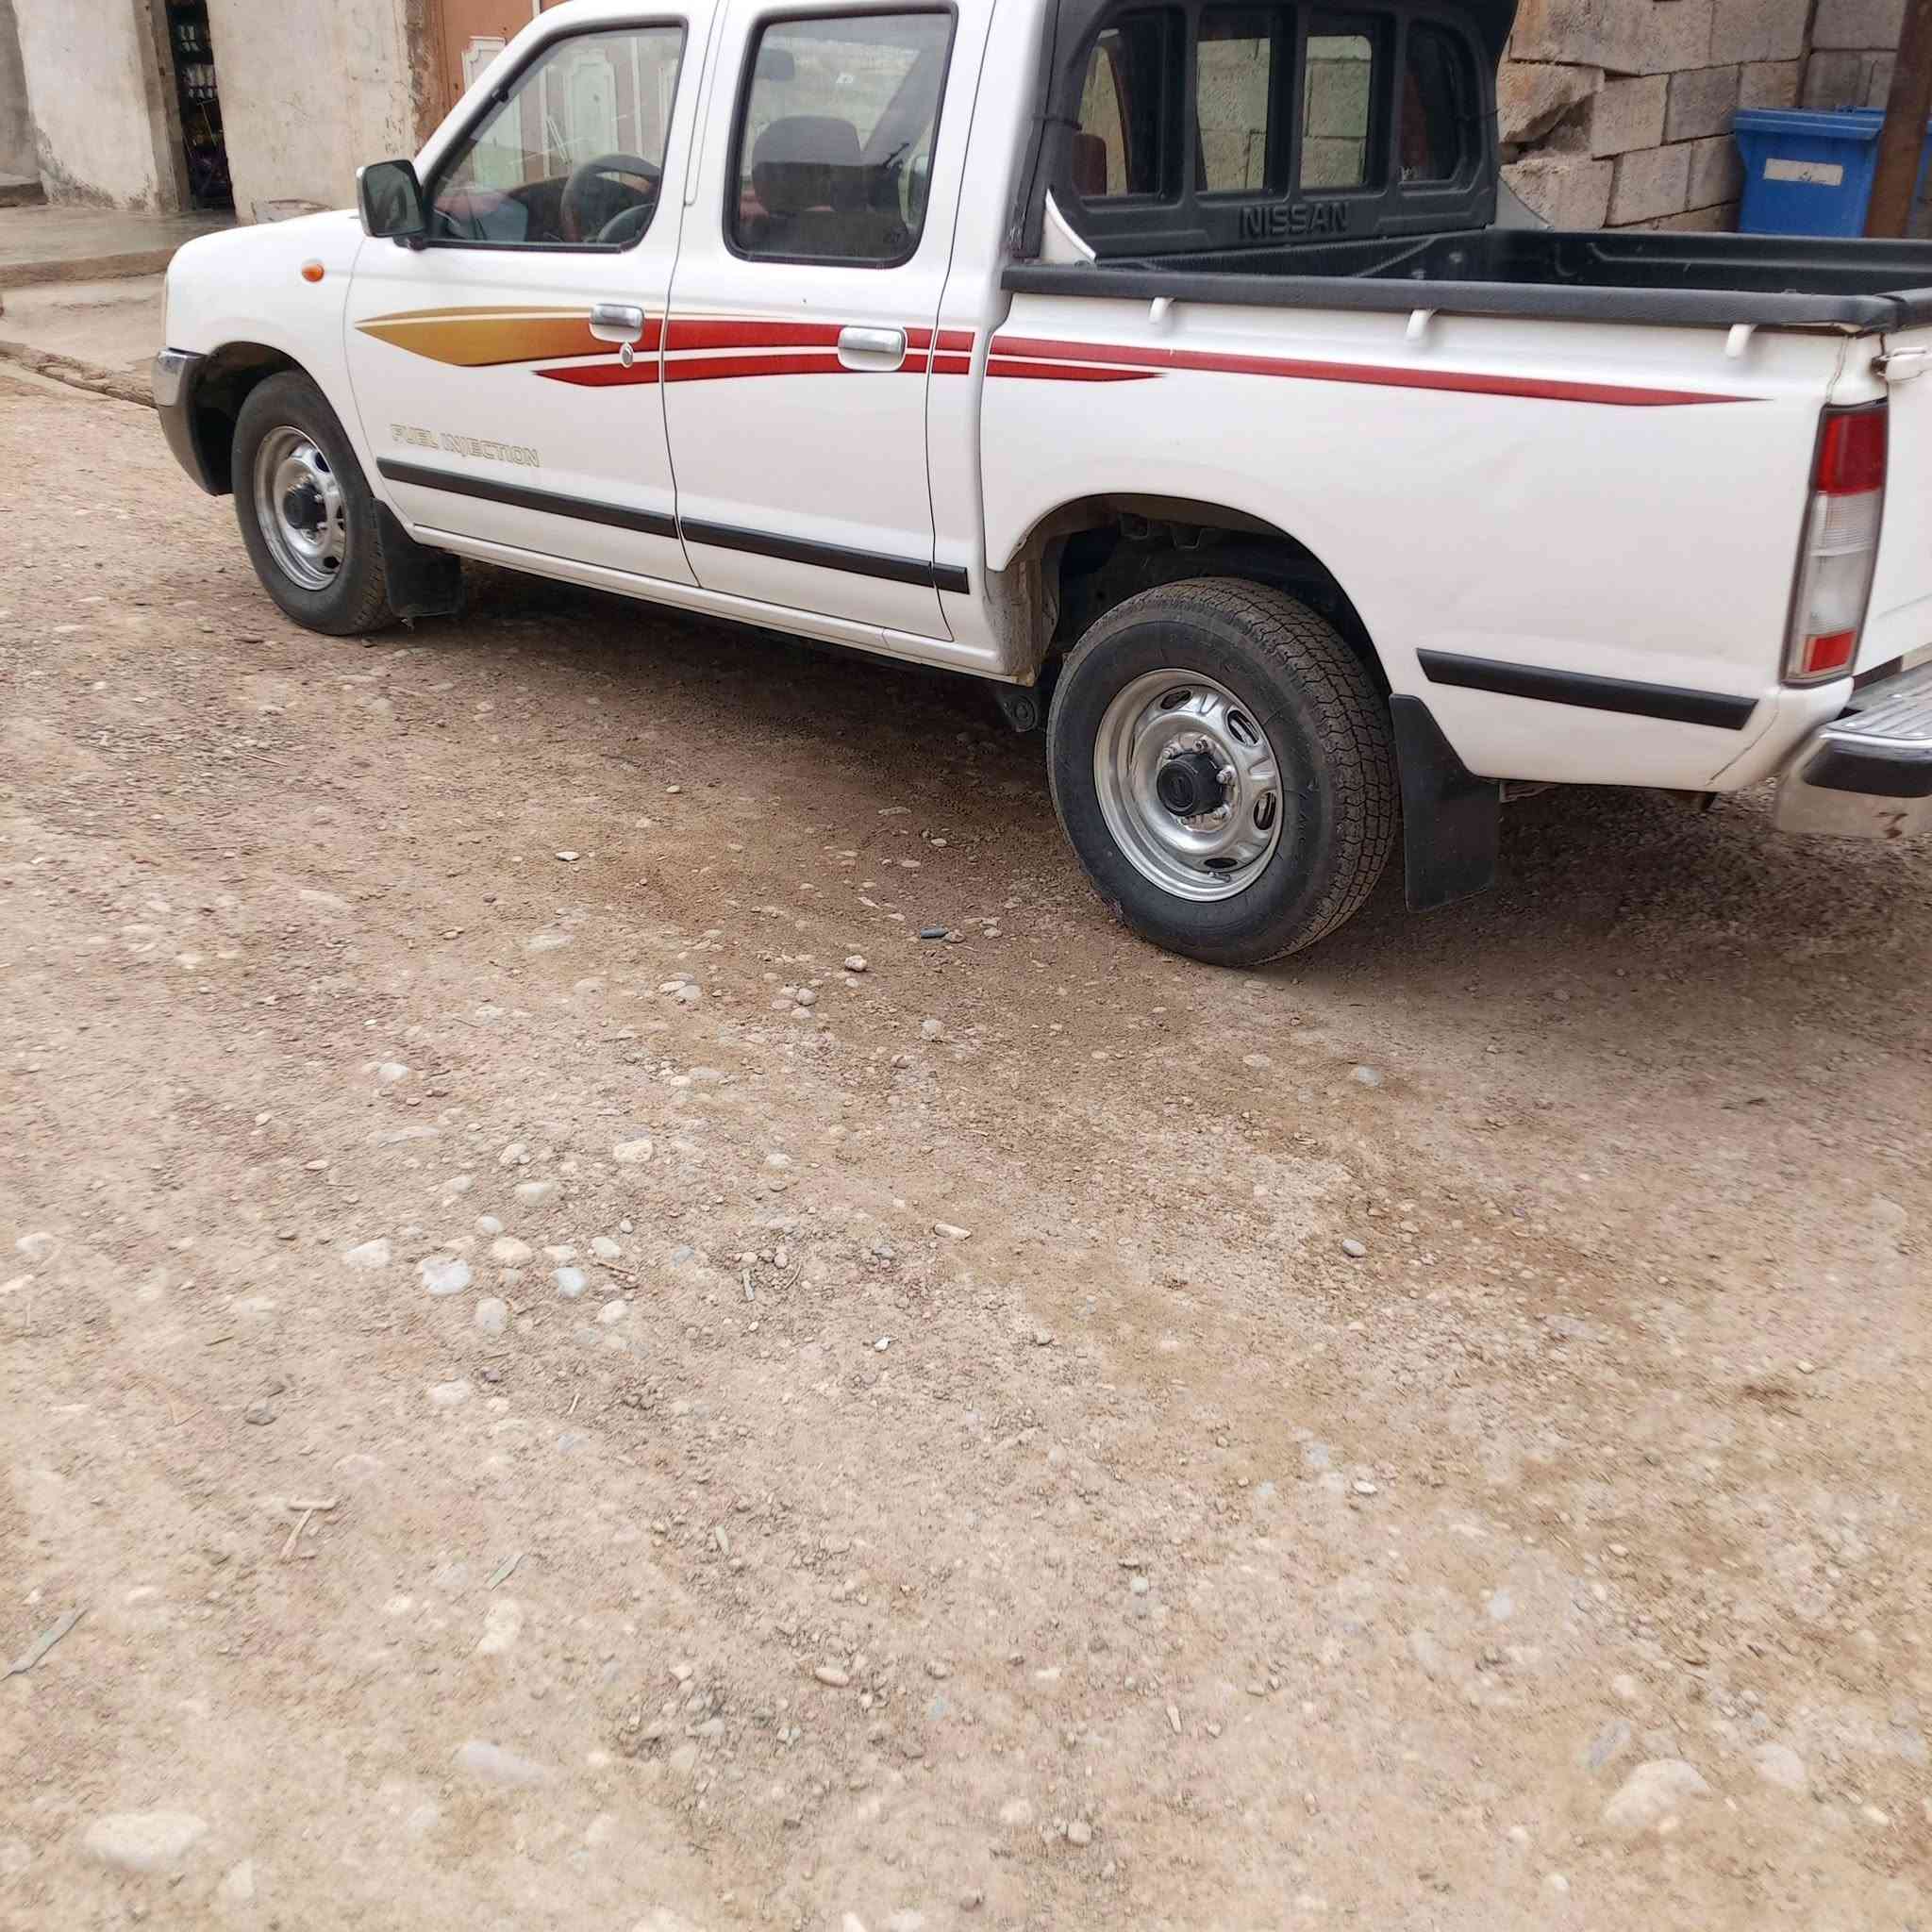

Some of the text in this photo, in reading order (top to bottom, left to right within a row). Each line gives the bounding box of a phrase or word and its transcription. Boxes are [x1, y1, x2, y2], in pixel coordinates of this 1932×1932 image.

[1239, 202, 1350, 239] NISSAN
[390, 423, 541, 468] FUEL INJECTION
